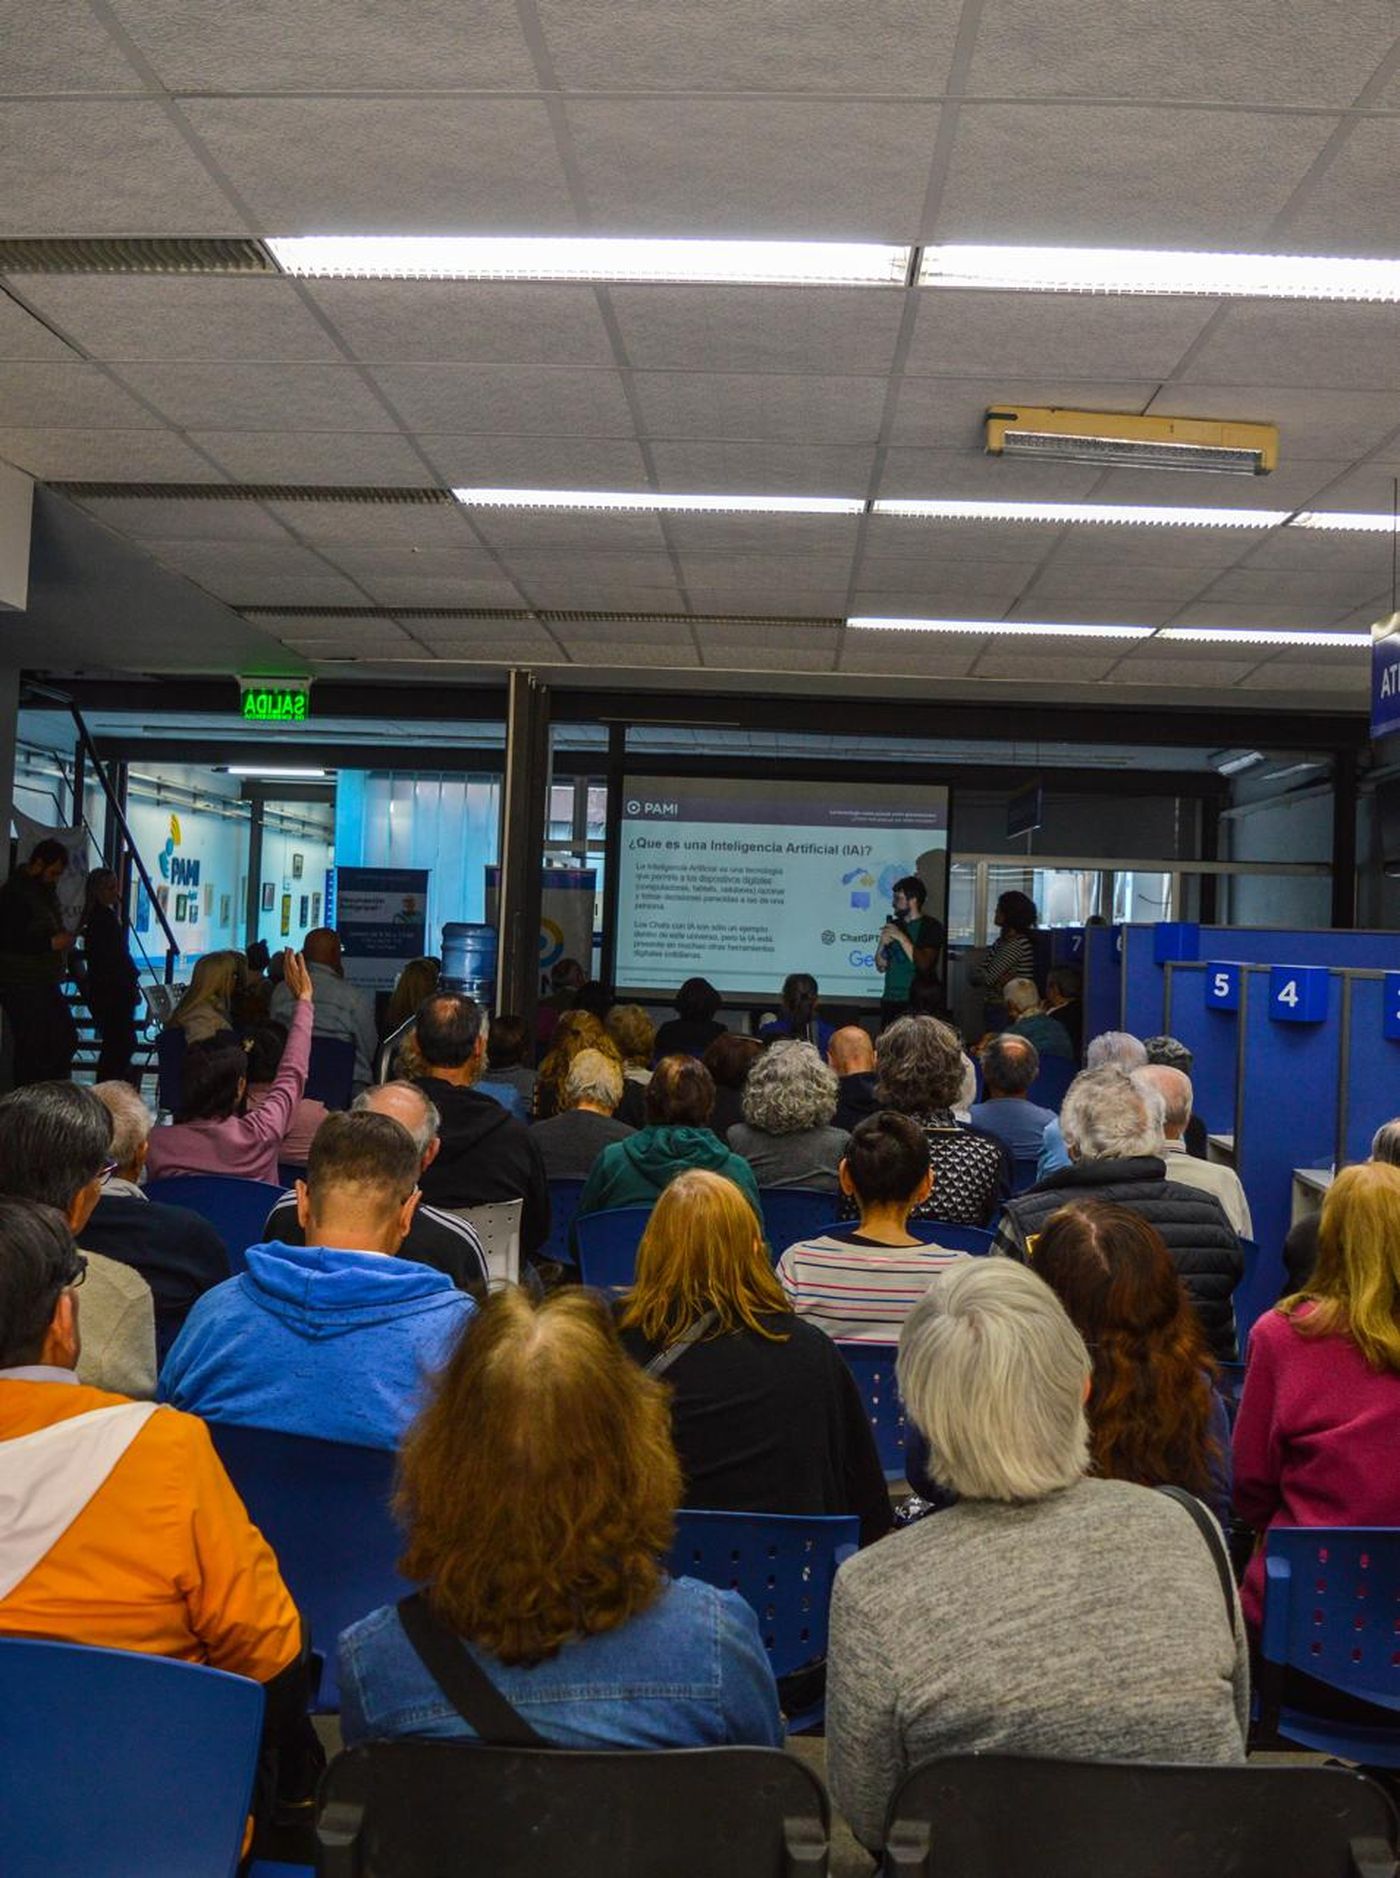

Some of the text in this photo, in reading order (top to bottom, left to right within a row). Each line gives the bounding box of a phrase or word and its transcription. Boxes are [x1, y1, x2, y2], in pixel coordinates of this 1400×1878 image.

[644, 802, 679, 815] PAMI
[665, 840, 680, 850] es
[684, 840, 707, 850] una
[711, 839, 783, 854] Inteligencia
[786, 842, 839, 855] Artificial
[842, 845, 872, 857] (IA)?
[171, 857, 200, 887] PAMI
[840, 933, 880, 943] ChatGPT
[1072, 935, 1082, 952] 7
[849, 950, 875, 968] Ge
[1213, 973, 1230, 997] 5
[1277, 980, 1299, 1008] 4
